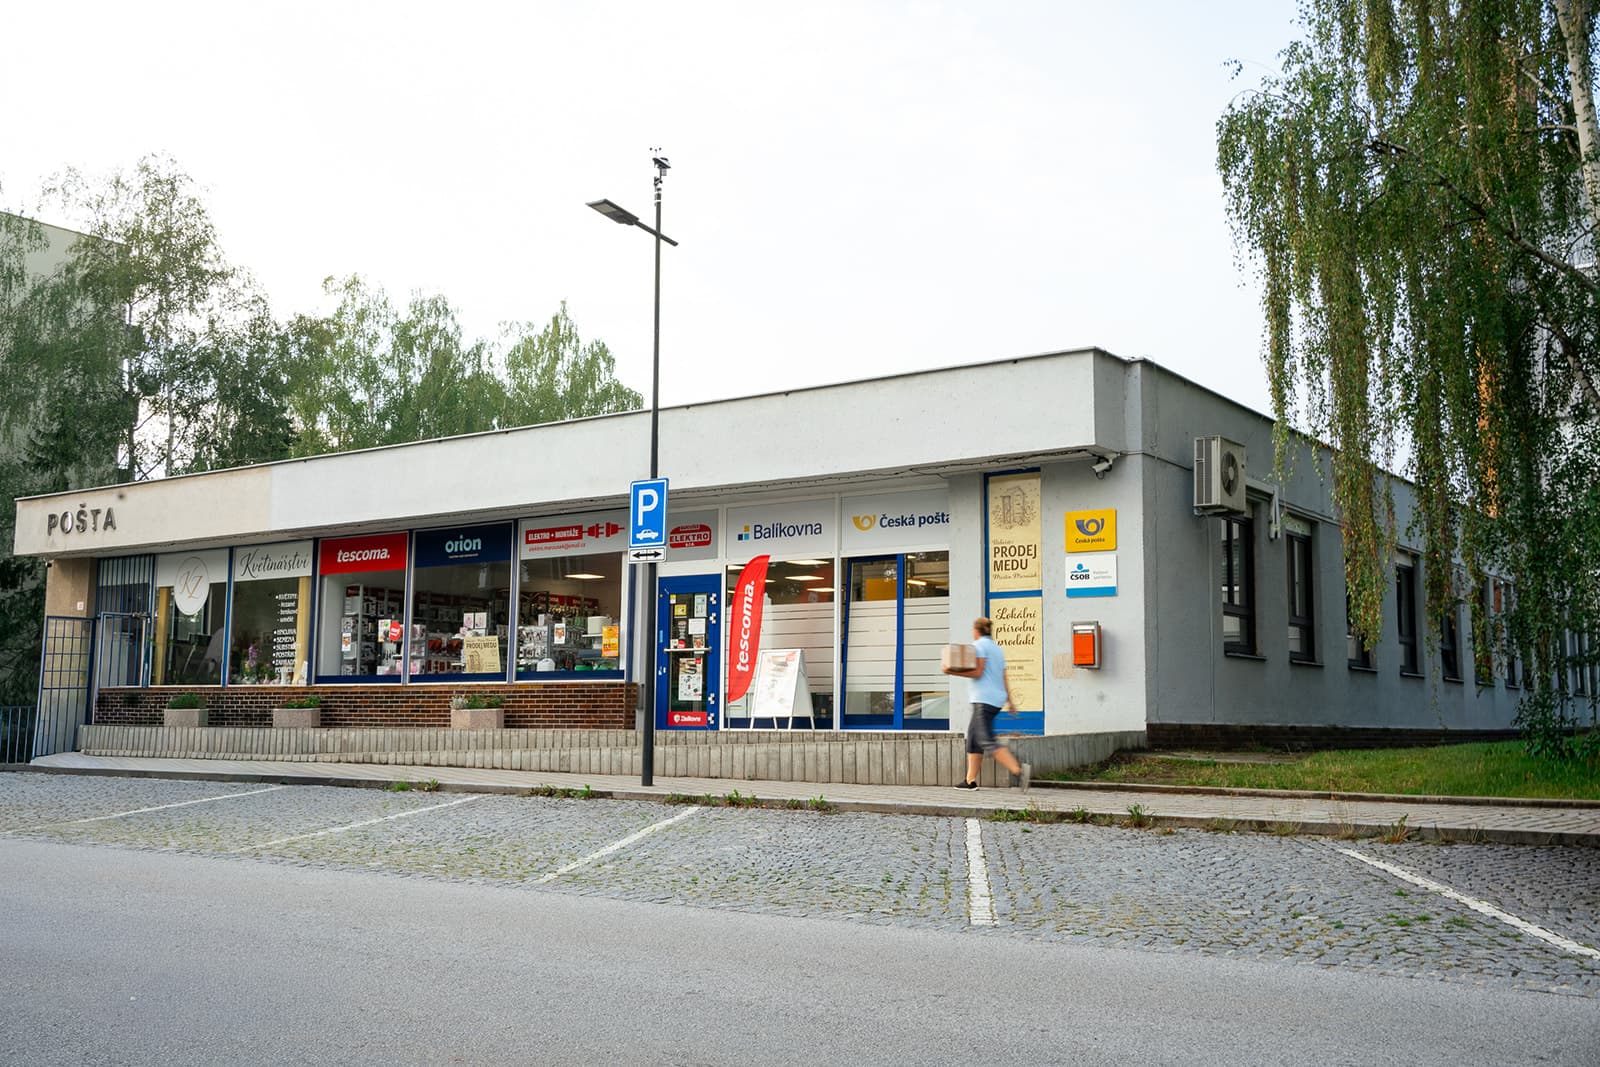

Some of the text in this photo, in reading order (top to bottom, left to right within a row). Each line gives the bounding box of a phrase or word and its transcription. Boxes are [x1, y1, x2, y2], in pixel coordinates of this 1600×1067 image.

[638, 489, 659, 526] P
[47, 502, 117, 537] POŠTA
[880, 513, 915, 528] Česká
[670, 532, 709, 542] ELEKTRO
[753, 522, 823, 540] Balíkovna
[445, 534, 482, 553] orion
[993, 544, 1037, 559] PRODEJ
[336, 548, 390, 563] tescoma.
[993, 558, 1028, 572] MEDU
[736, 580, 755, 672] tescoma.
